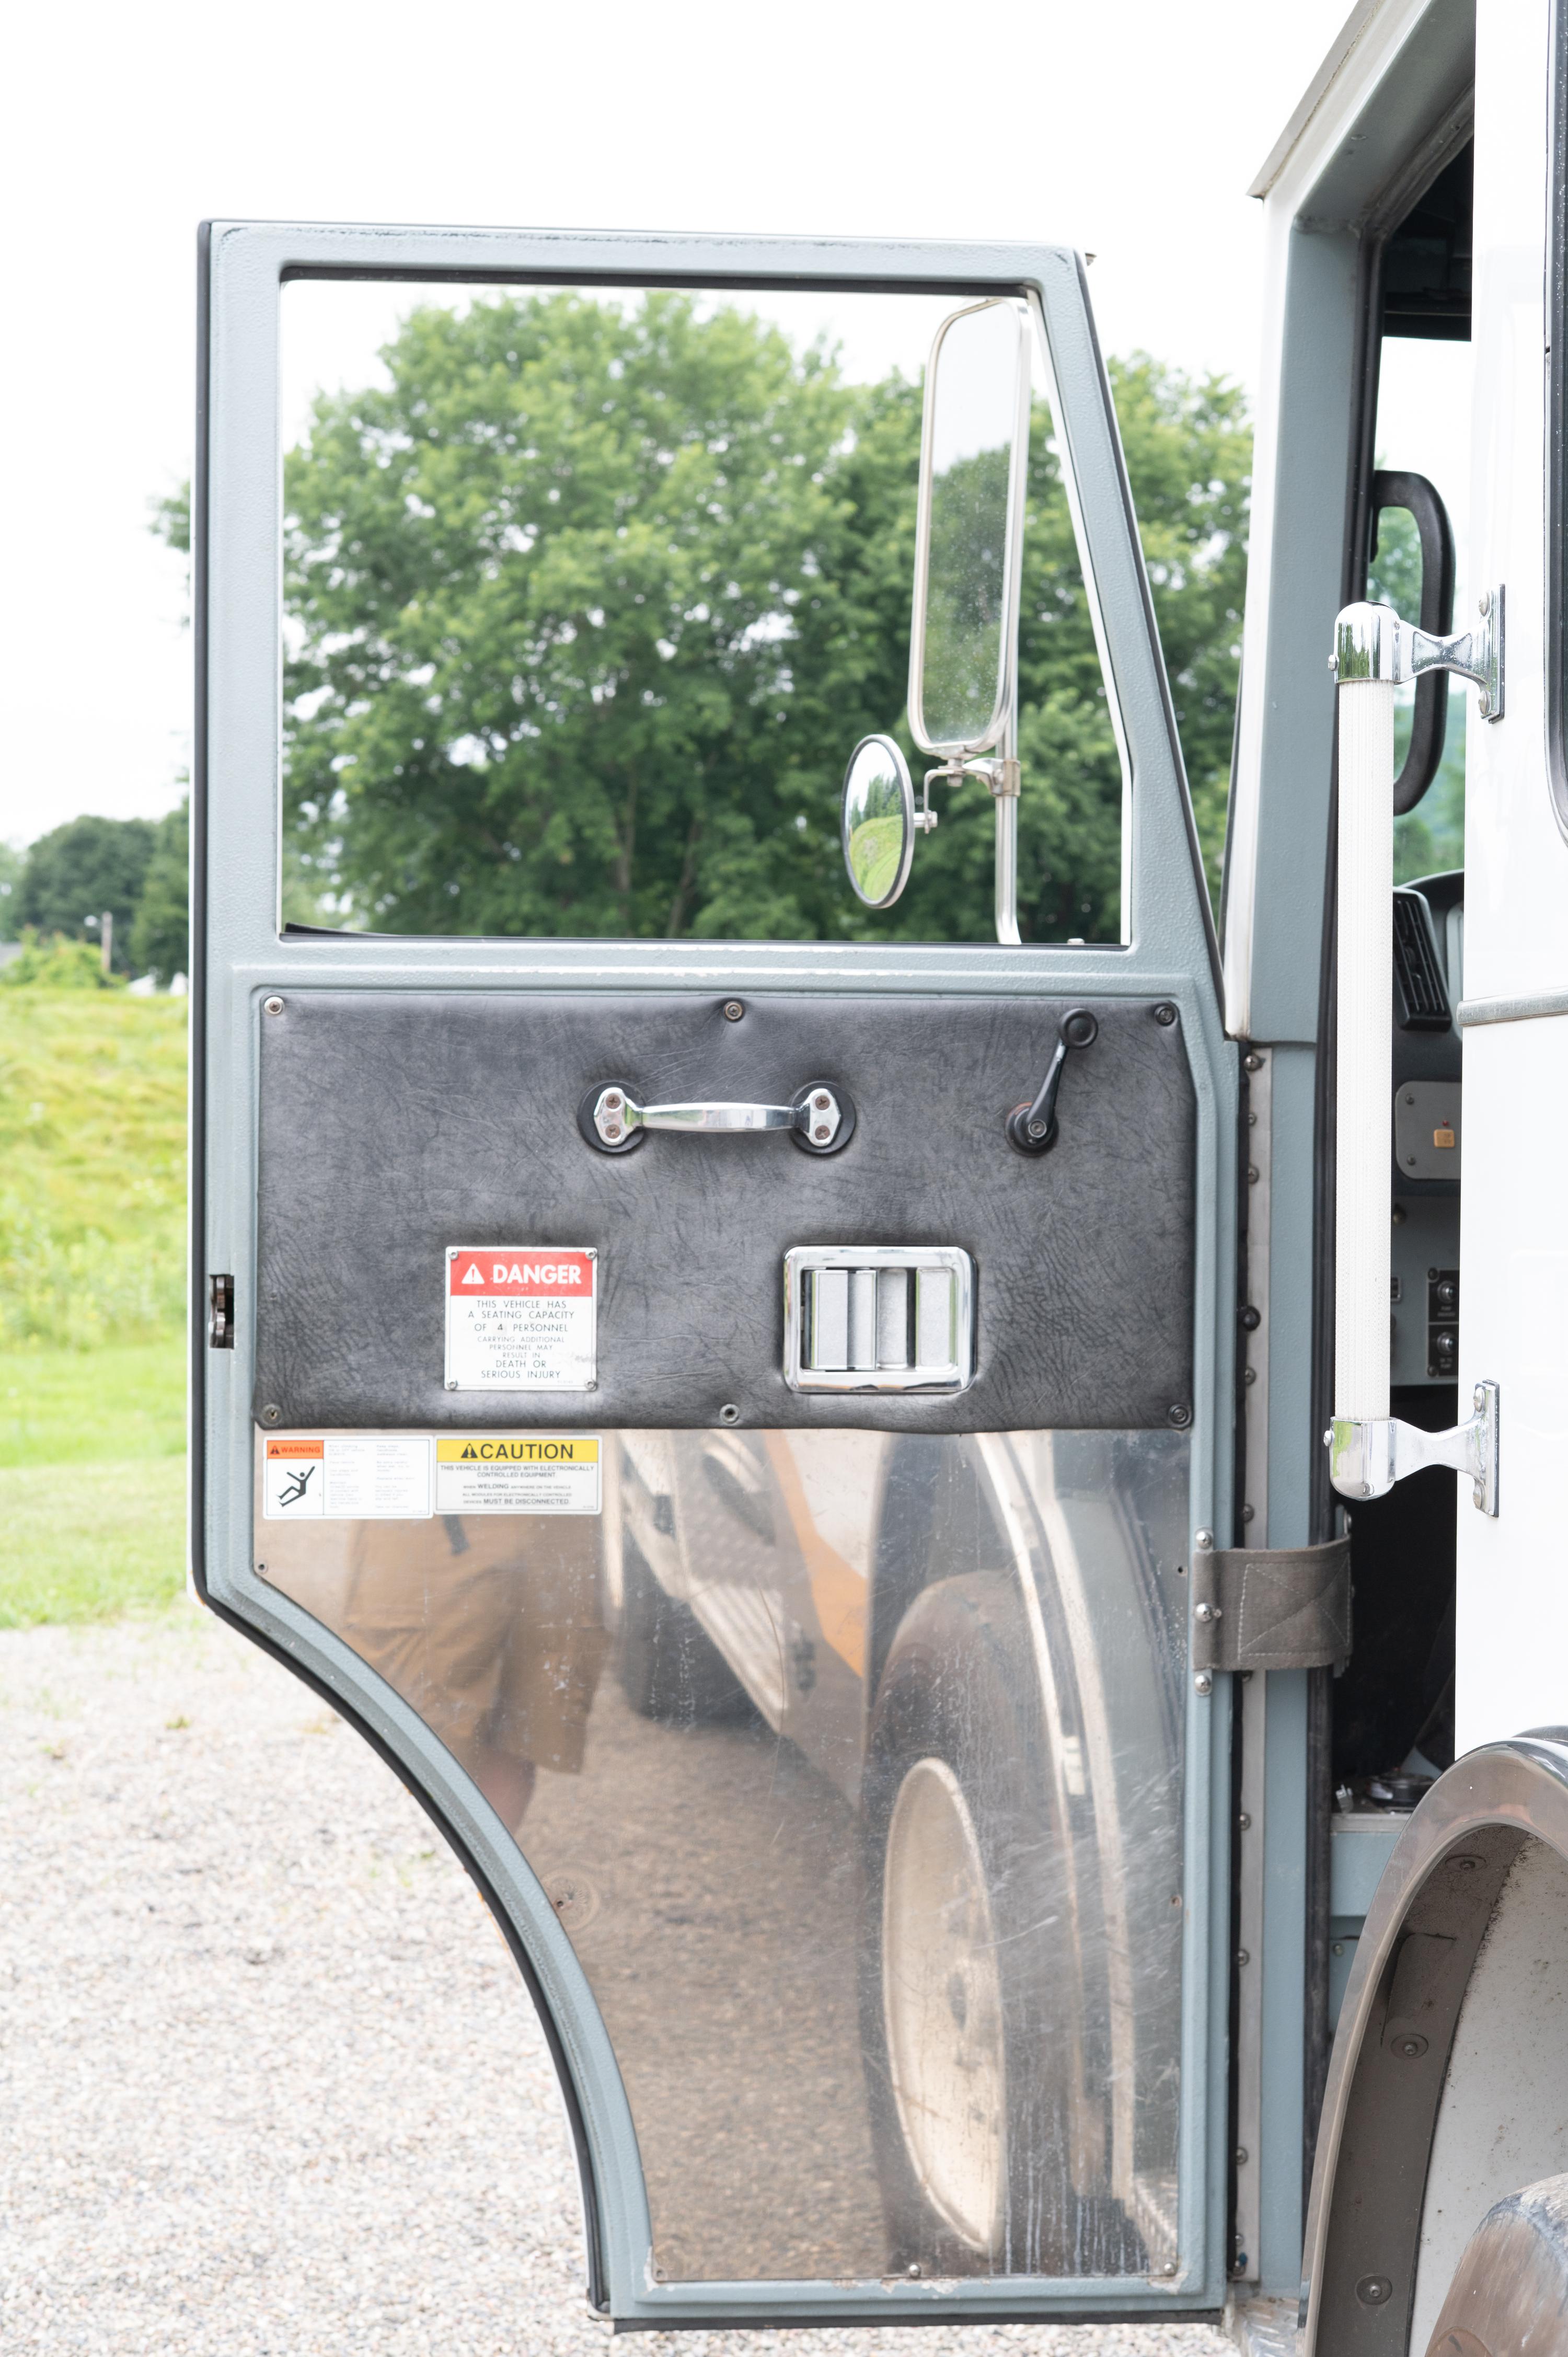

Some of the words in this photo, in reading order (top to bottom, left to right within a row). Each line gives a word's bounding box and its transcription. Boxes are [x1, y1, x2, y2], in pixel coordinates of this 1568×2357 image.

[493, 1264, 582, 1284] DANGER
[477, 1300, 496, 1308] THIS
[503, 1300, 540, 1308] VEHICLE
[513, 1324, 568, 1332] PERSONNEL
[480, 1443, 573, 1459] CAUTION
